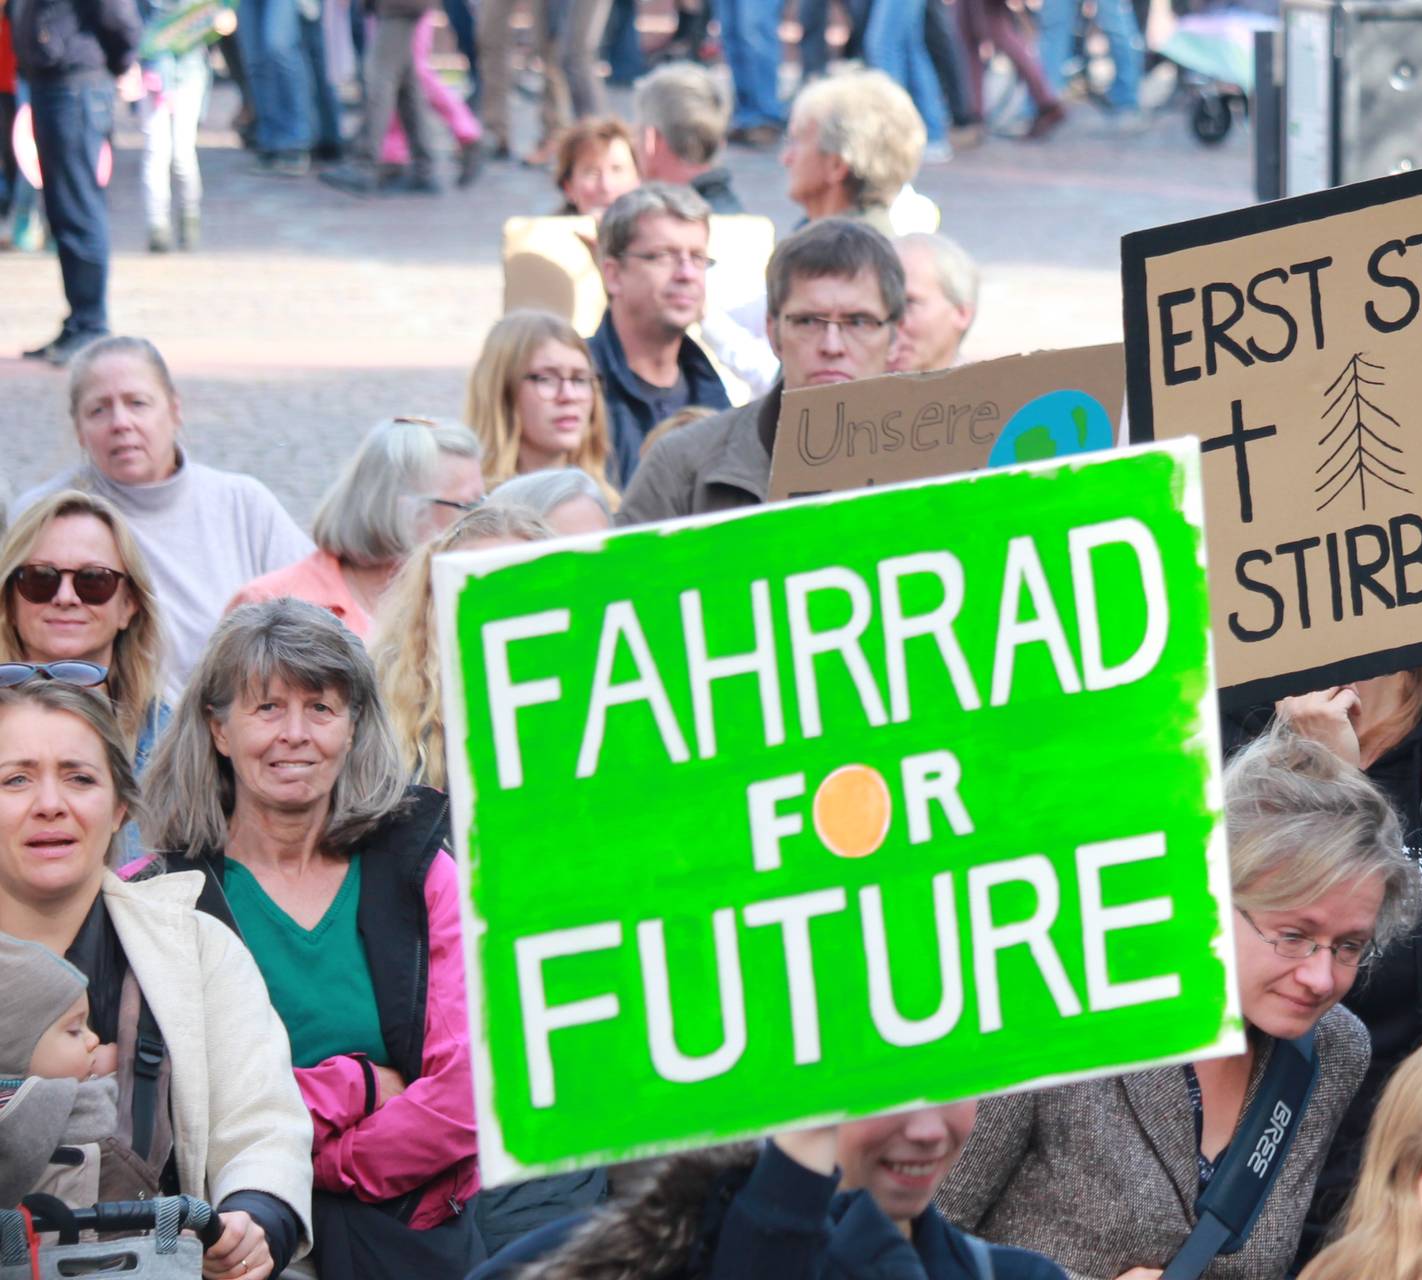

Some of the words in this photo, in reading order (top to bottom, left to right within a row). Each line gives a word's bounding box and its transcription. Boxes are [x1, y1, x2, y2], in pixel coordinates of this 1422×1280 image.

[1157, 256, 1333, 386] ERST
[797, 401, 1000, 466] Unsere
[481, 517, 1170, 790] FAHRRAD
[746, 749, 974, 872] FOR
[514, 830, 1182, 1108] FUTURE
